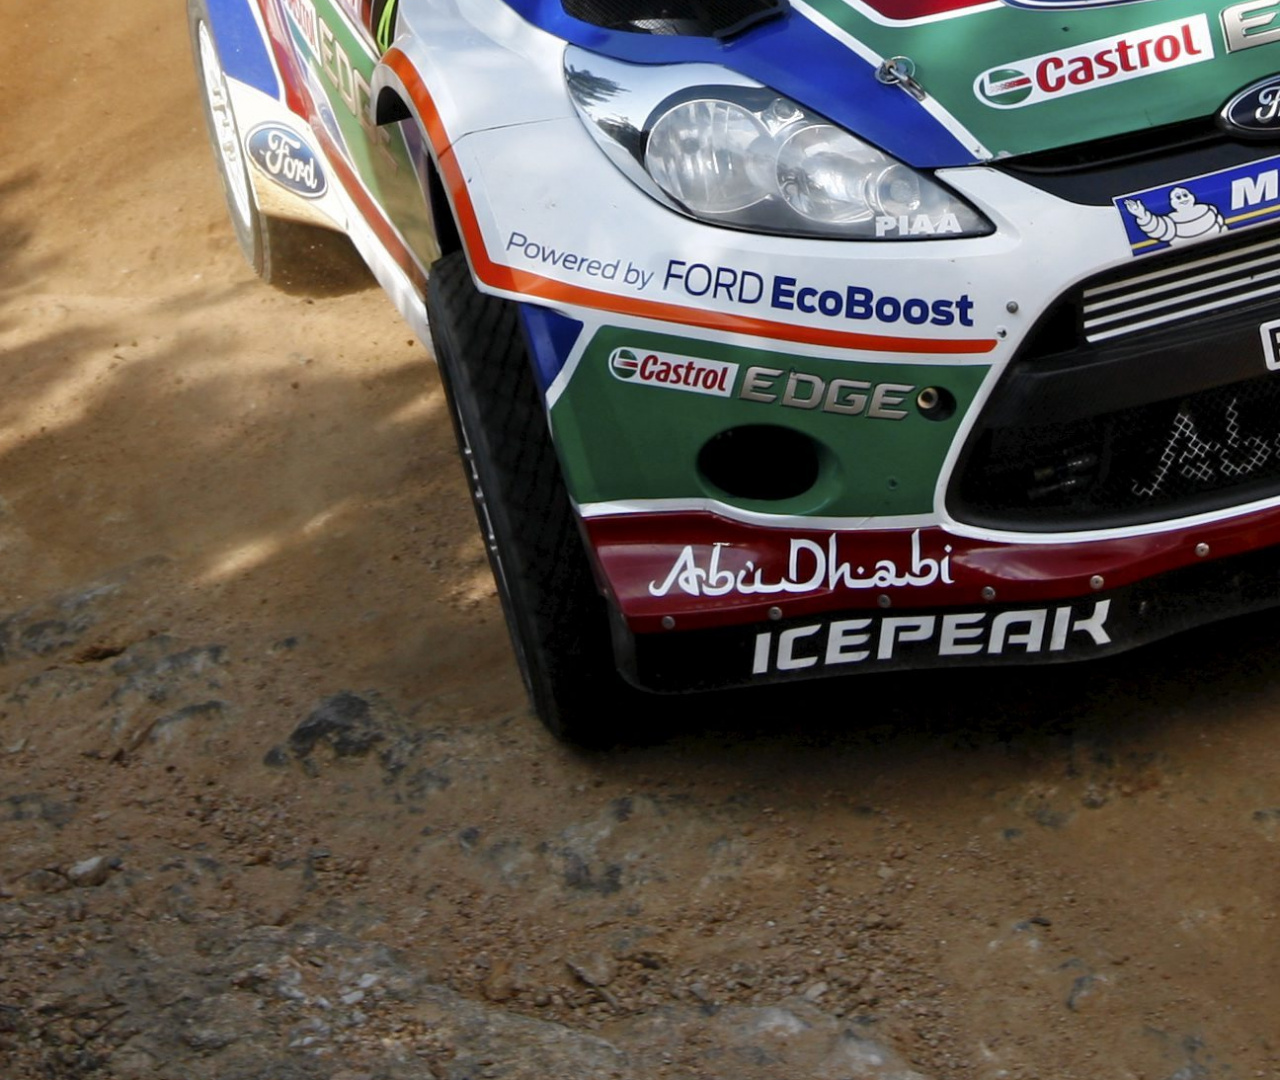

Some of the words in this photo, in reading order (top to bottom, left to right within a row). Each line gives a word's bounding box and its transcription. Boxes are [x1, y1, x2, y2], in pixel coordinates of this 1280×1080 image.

[1035, 24, 1203, 96] Castrol
[265, 130, 317, 189] Ford
[874, 213, 963, 238] PIAA
[505, 231, 620, 282] Powered
[624, 256, 655, 291] by
[662, 259, 764, 306] FORD
[769, 276, 975, 327] EcoBoost
[638, 354, 729, 392] Castrol
[738, 366, 916, 420] EDGE
[752, 598, 1113, 675] ICEPEAK
